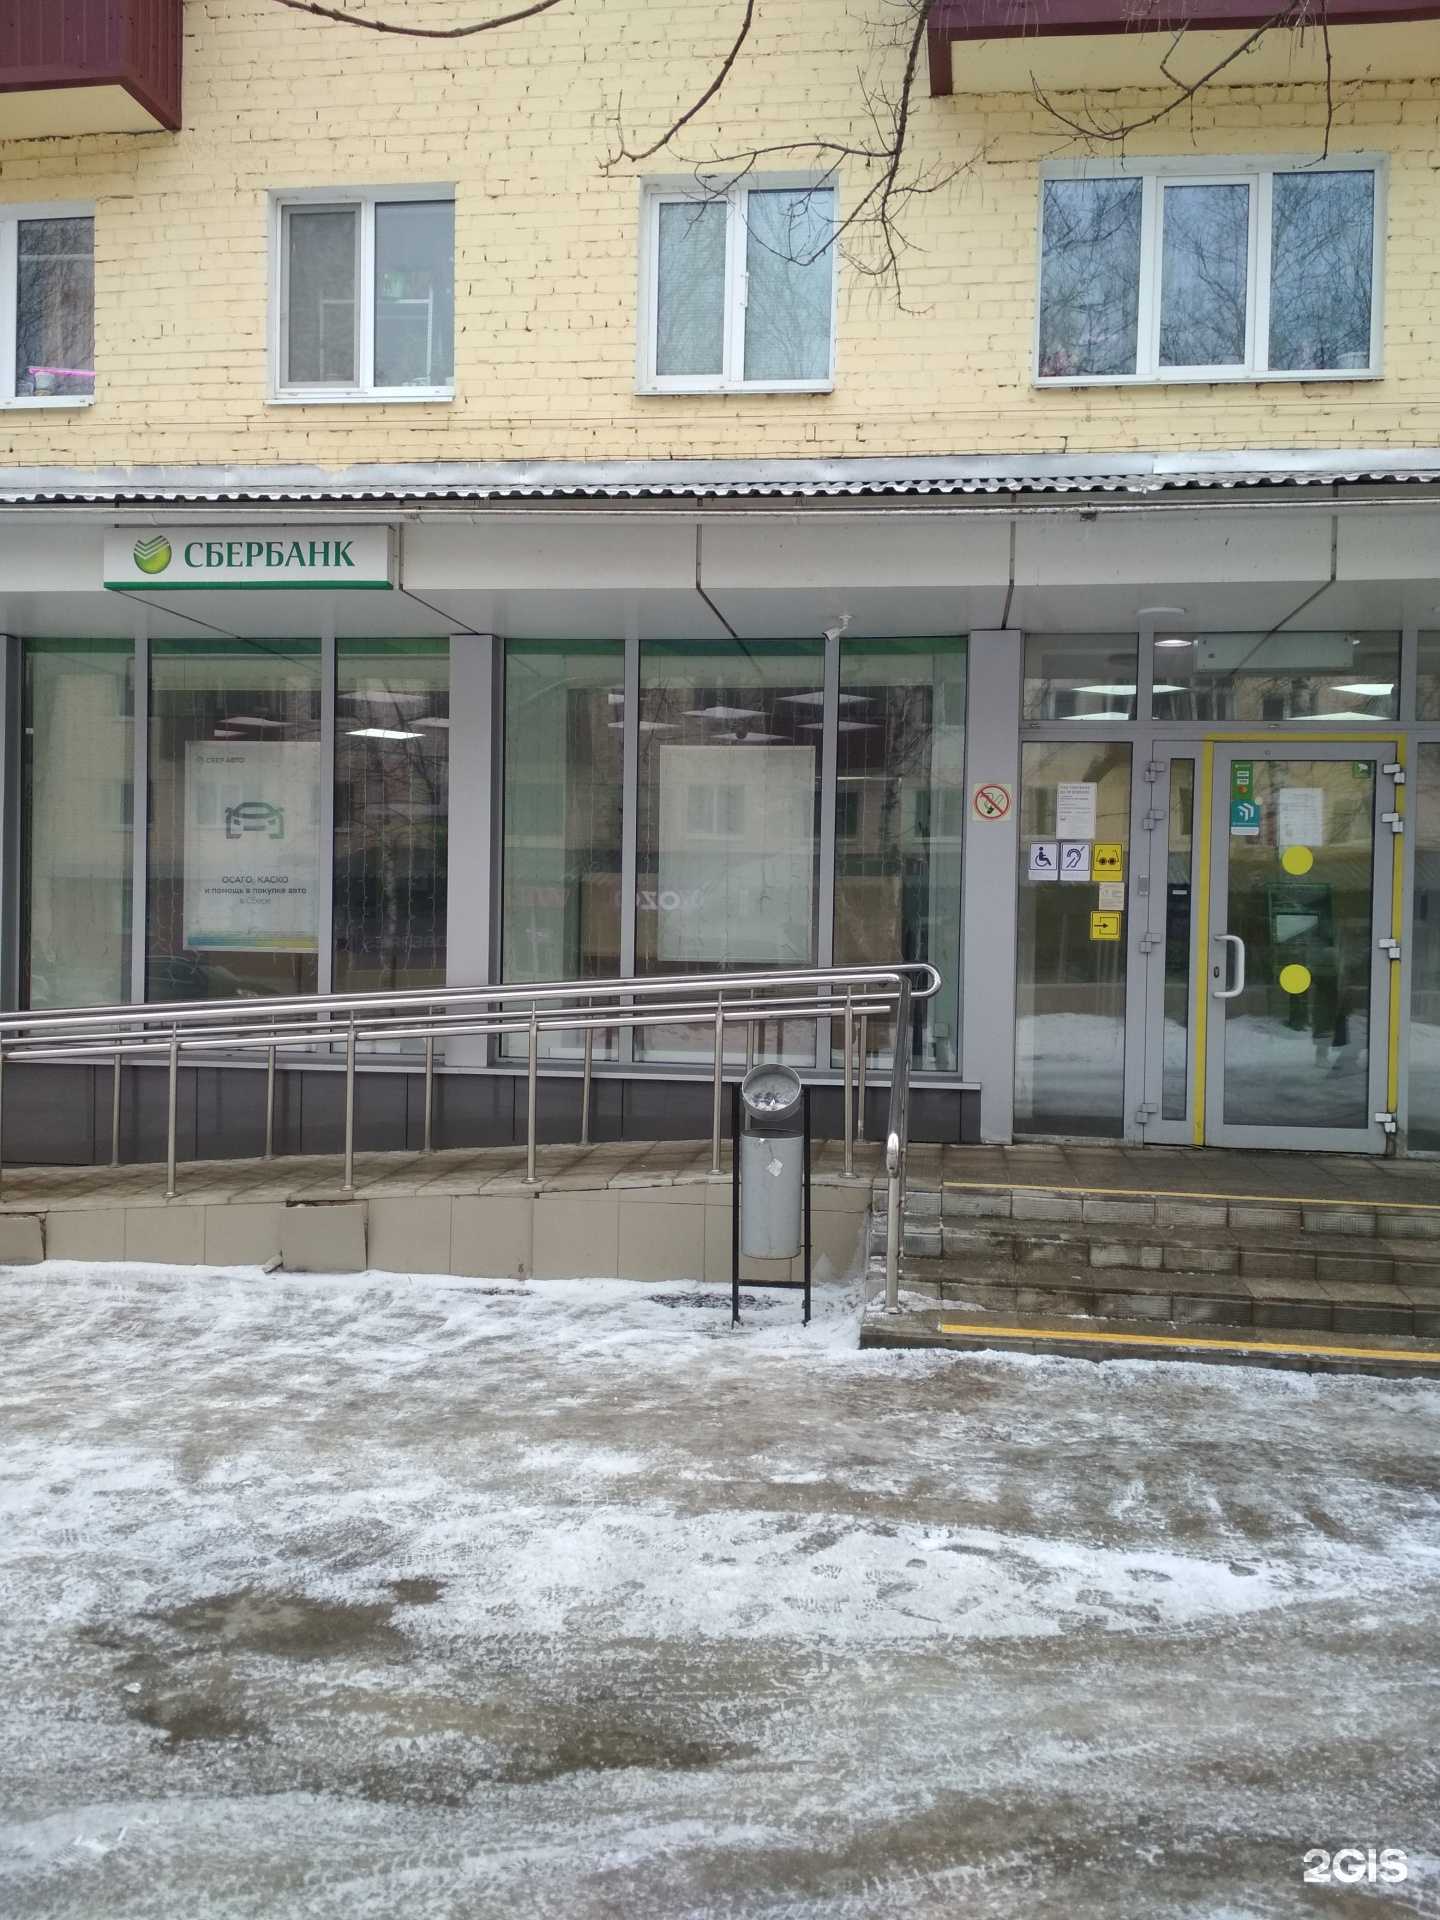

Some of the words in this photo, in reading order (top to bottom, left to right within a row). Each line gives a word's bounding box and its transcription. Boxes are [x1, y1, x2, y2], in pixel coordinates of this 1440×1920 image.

[184, 540, 356, 568] СБЕРБАНК
[257, 875, 289, 884] КАСКО
[212, 887, 244, 895] помощь
[252, 887, 287, 896] покупке
